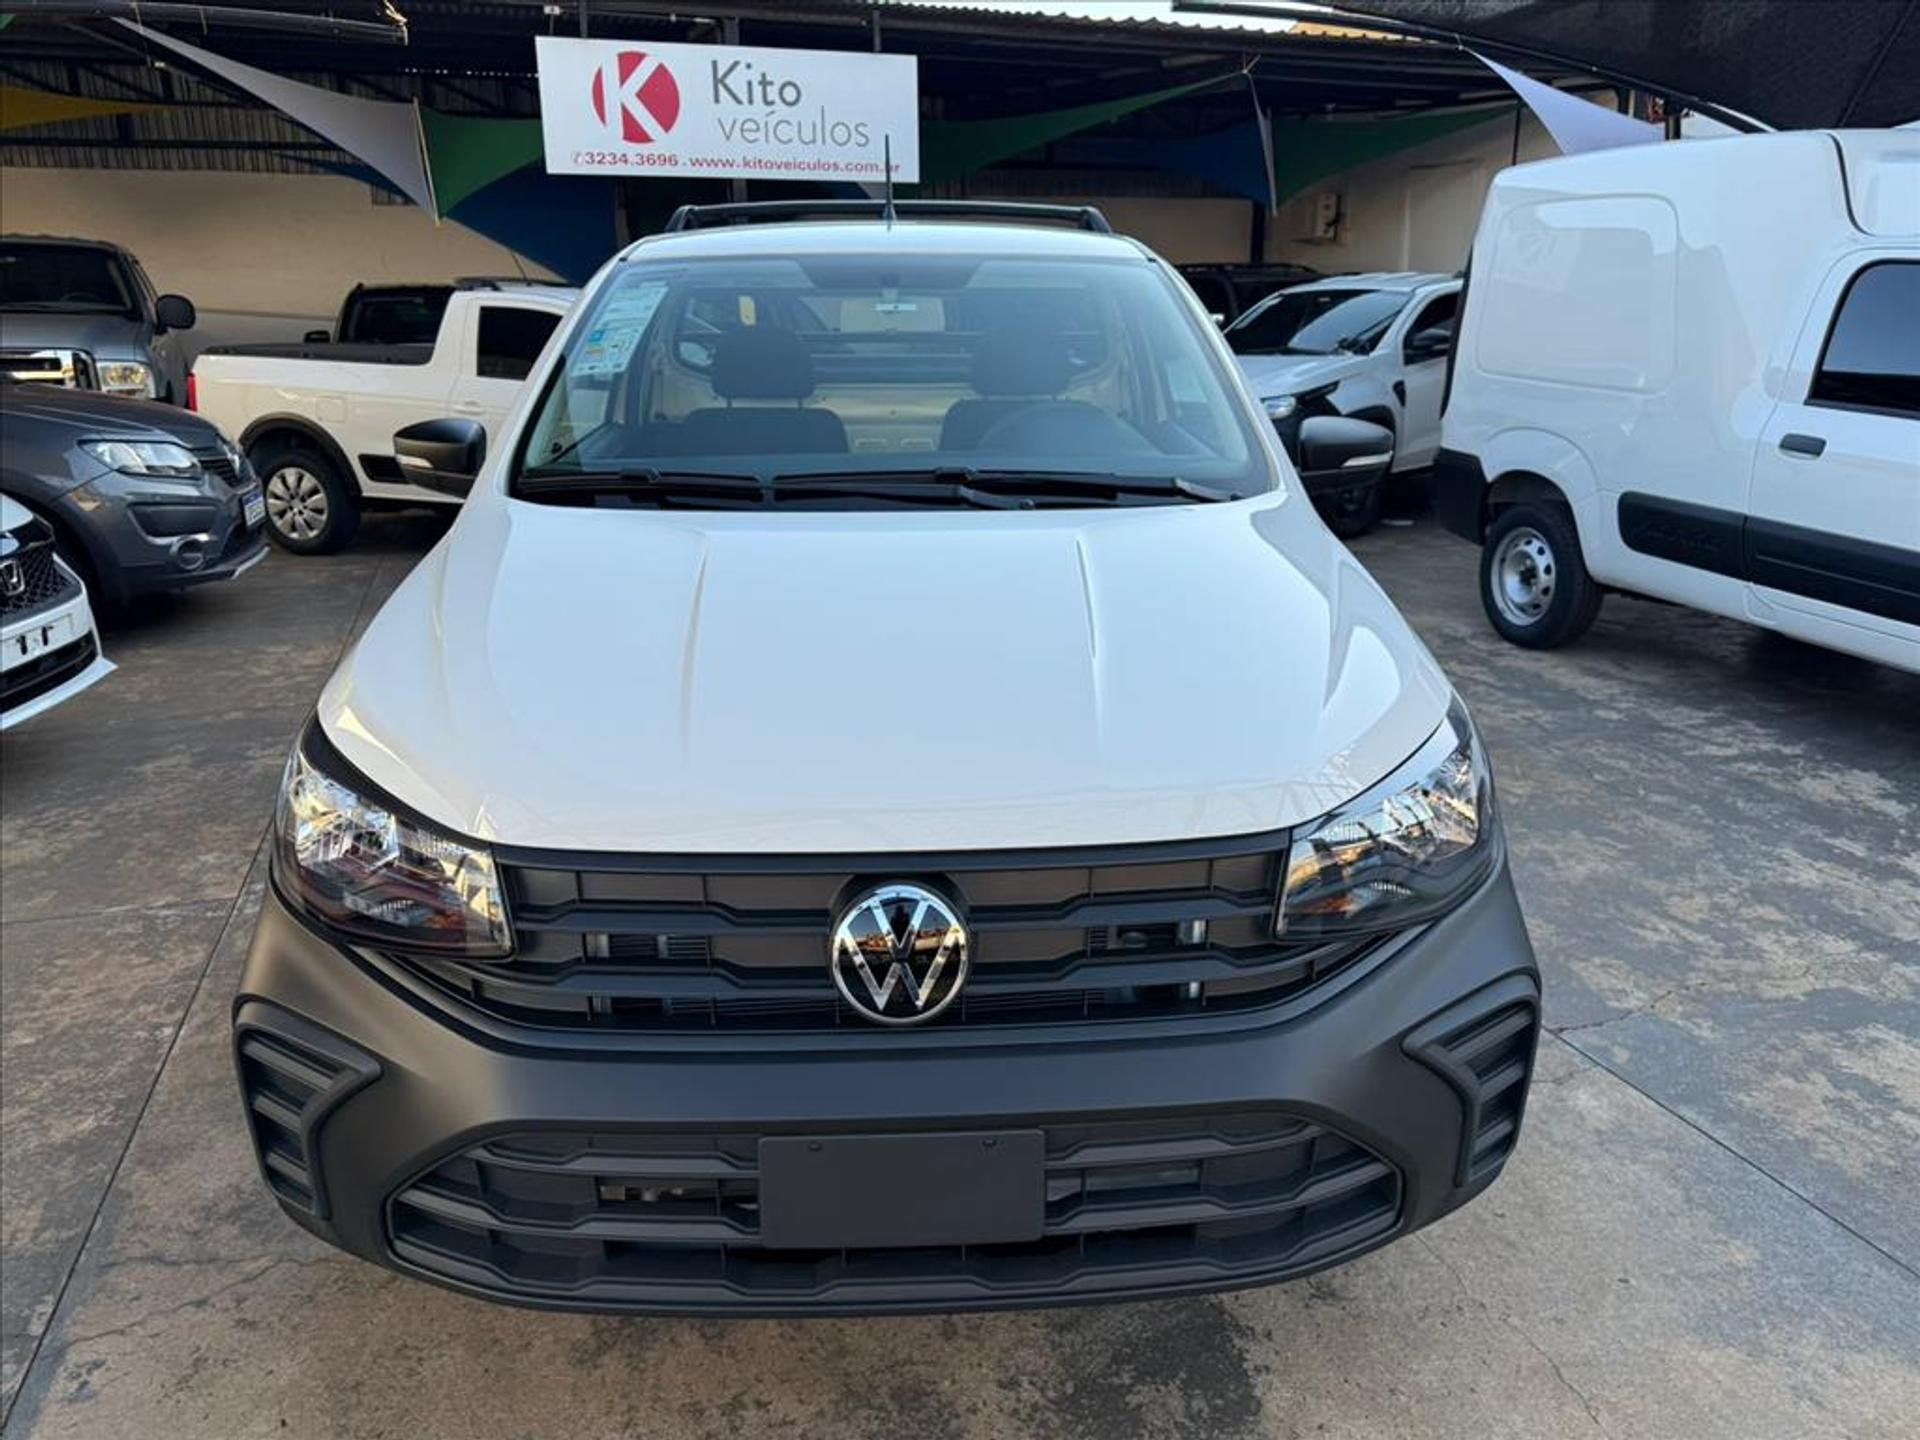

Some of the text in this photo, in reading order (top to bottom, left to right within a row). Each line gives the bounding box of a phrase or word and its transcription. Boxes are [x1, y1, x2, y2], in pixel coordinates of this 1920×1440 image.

[594, 50, 678, 144] K
[711, 60, 802, 107] Kito
[717, 106, 870, 148] veículos
